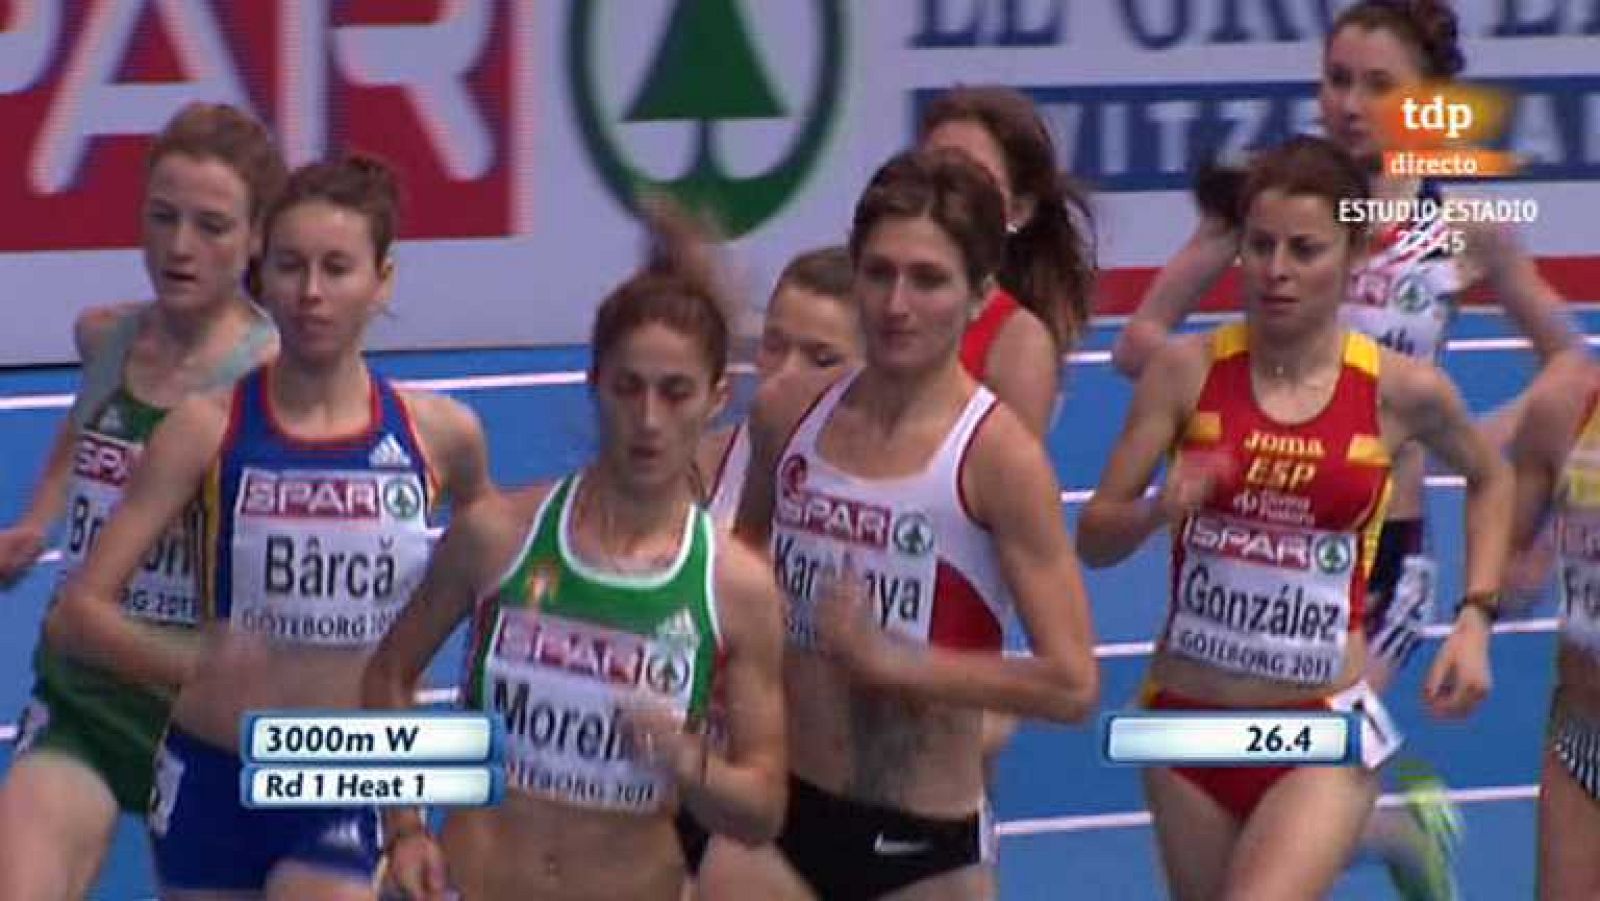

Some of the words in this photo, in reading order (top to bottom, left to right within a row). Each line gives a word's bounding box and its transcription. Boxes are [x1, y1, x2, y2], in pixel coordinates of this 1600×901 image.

[244, 477, 379, 516] SPAR
[1246, 458, 1317, 489] ESP
[776, 497, 893, 548] SPAR
[1188, 520, 1311, 569] SPAR
[265, 532, 396, 599] Bârcă
[1184, 563, 1340, 643] González
